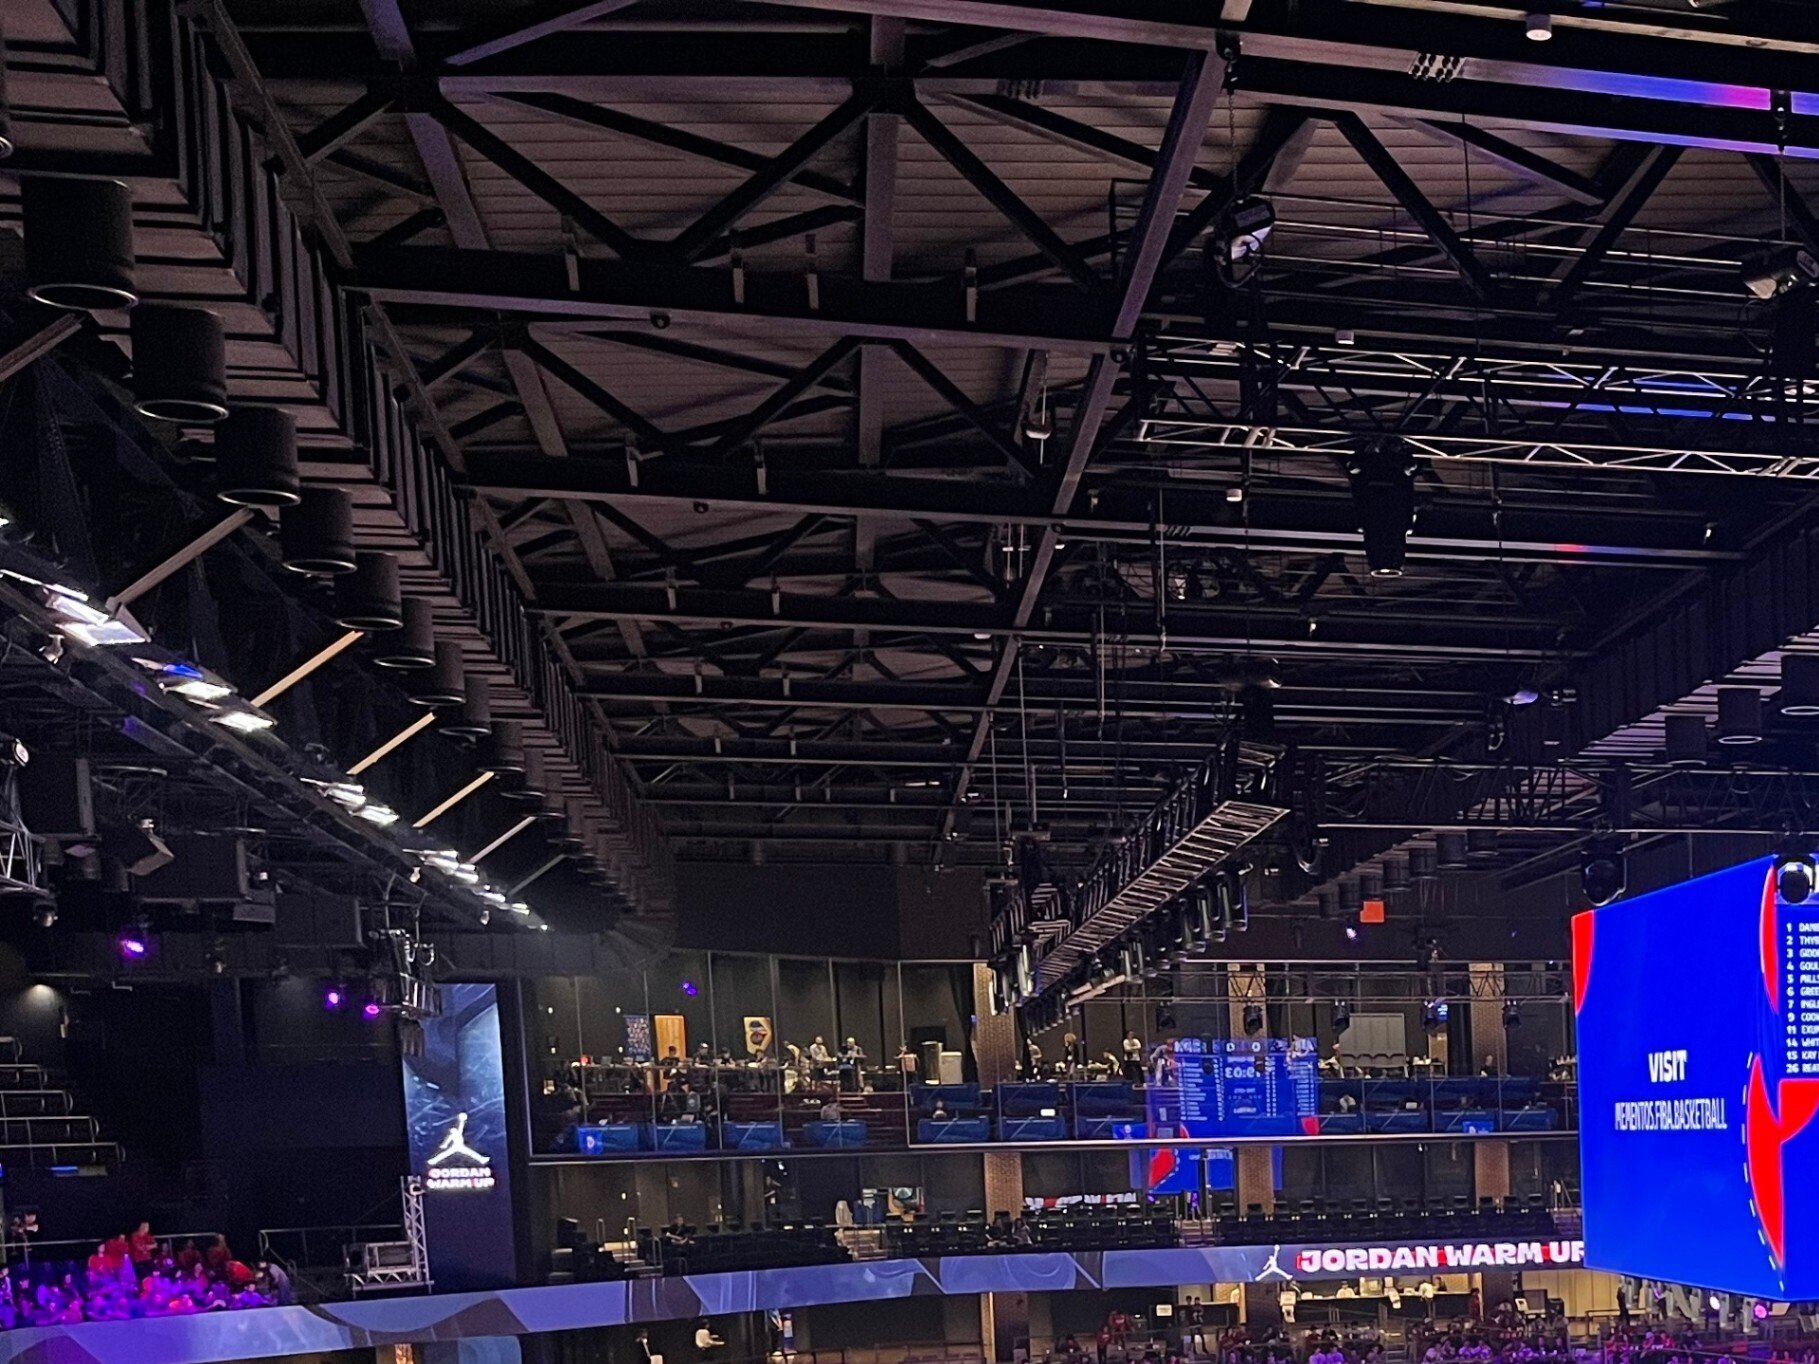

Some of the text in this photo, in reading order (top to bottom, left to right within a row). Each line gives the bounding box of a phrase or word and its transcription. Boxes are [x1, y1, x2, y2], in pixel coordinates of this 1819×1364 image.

[1648, 1049, 1688, 1083] VISIT
[1614, 1097, 1728, 1131] MEMENTOS.FIBA.BASKETBALL
[1300, 1247, 1439, 1273] JORDAN
[1443, 1242, 1545, 1267] WARM
